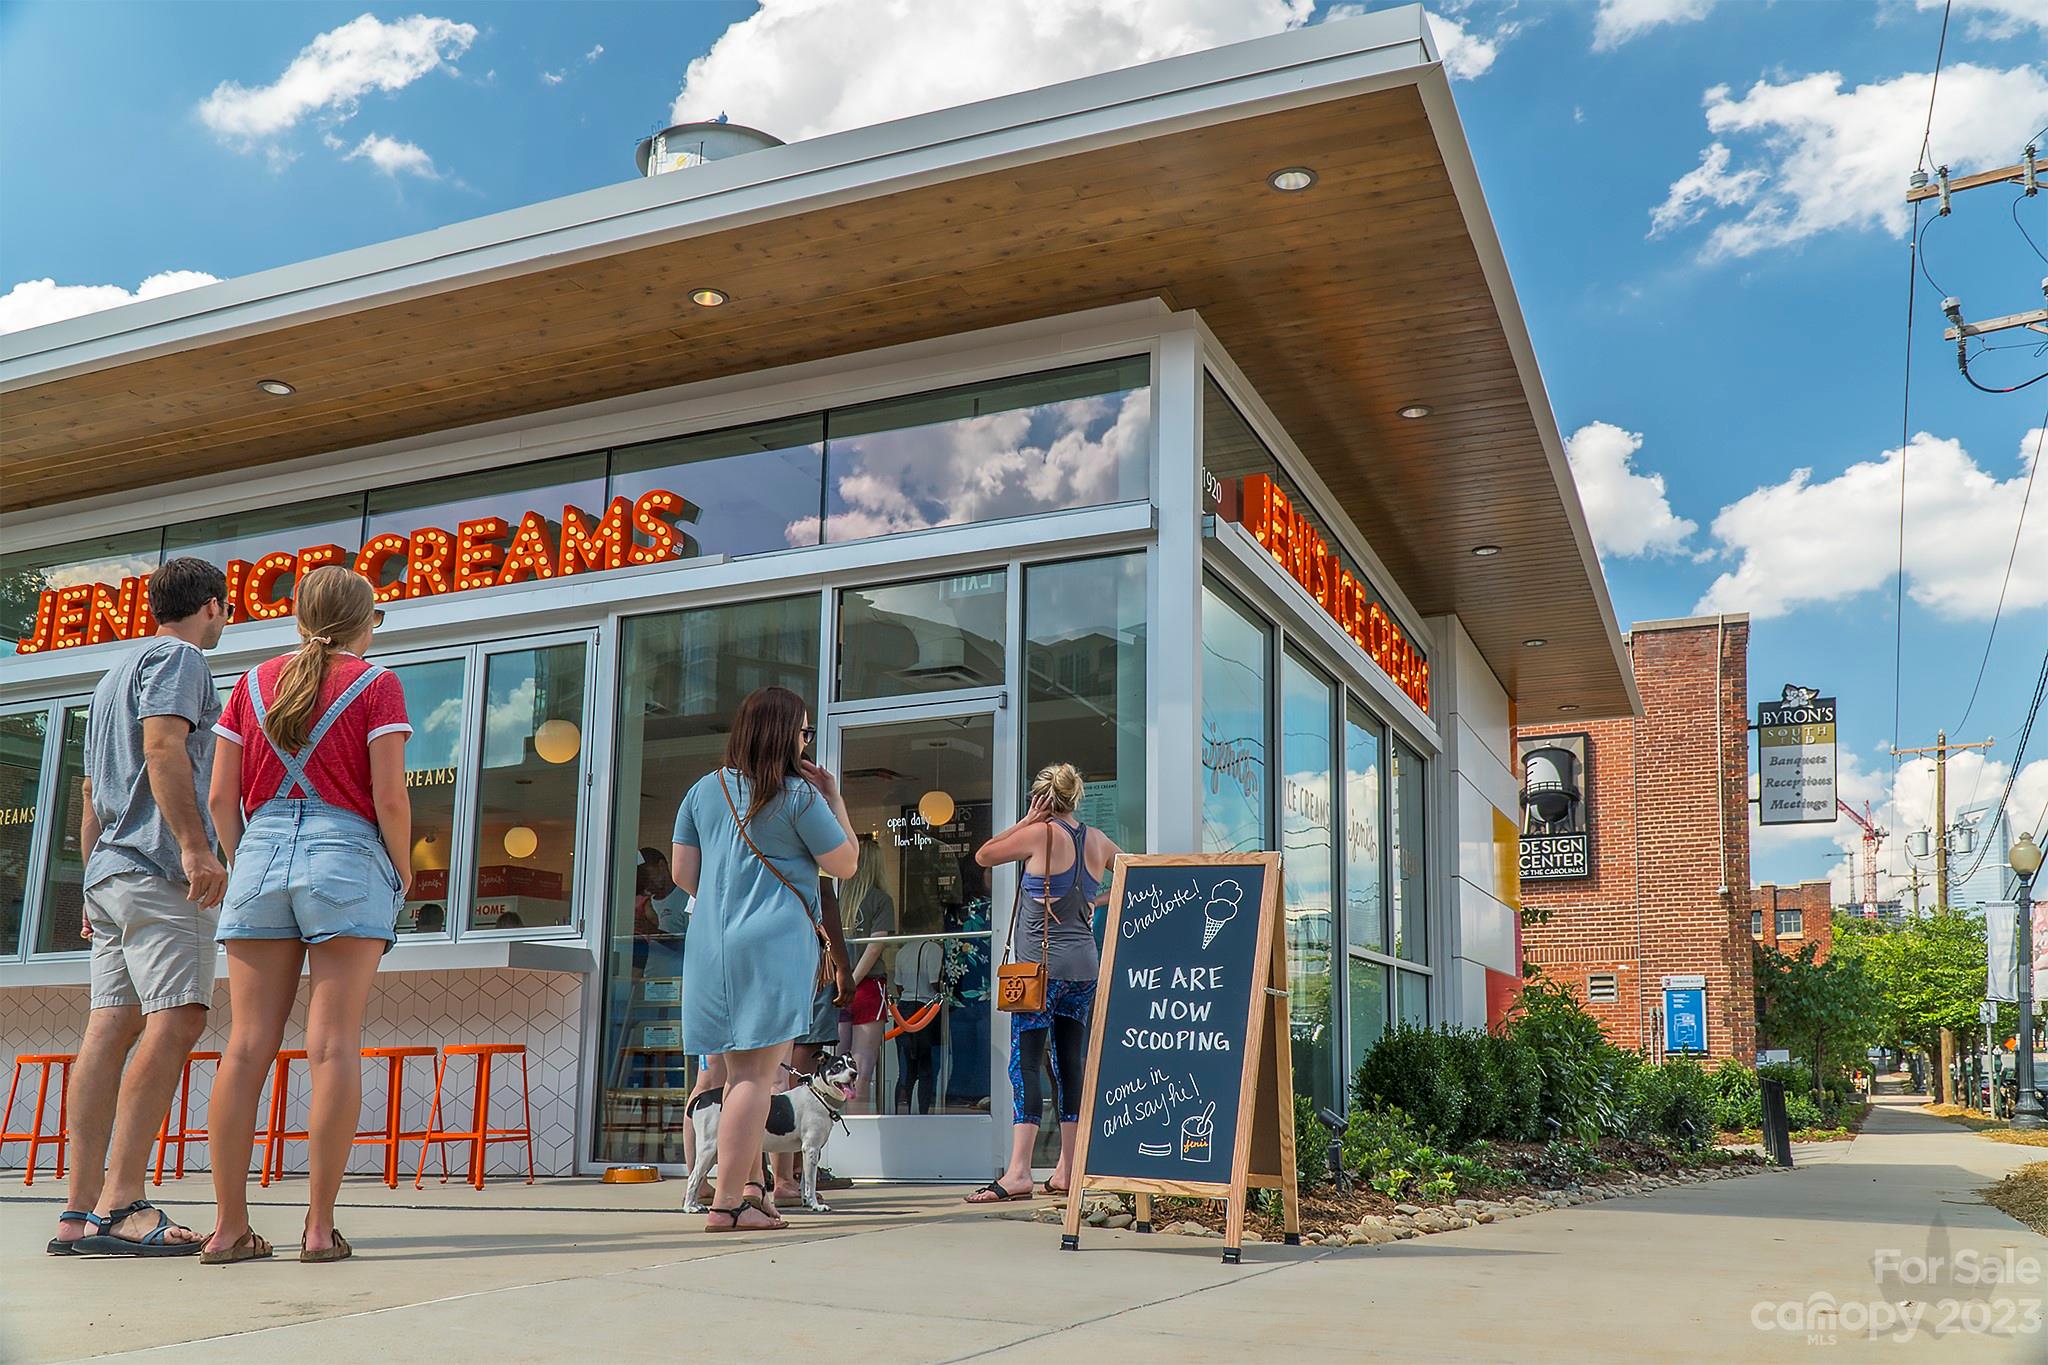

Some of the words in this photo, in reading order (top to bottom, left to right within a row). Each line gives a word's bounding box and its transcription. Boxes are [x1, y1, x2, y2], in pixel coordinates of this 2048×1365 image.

[1202, 466, 1222, 504] 1920
[16, 574, 158, 655] JENI
[353, 489, 685, 604] CREAMS
[1331, 556, 1367, 648] ICE
[1762, 707, 1834, 726] BYRON'S
[1767, 726, 1828, 738] SOUTH
[1769, 756, 1828, 768] Banquets
[406, 767, 456, 788] REAMS
[1765, 775, 1833, 790] Receptions
[1769, 798, 1829, 812] Meetings
[0, 806, 36, 826] REAMS
[886, 817, 908, 833] open
[910, 811, 932, 831] daily
[1518, 838, 1584, 856] DESIGN
[1518, 852, 1585, 870] CENTER
[1518, 869, 1530, 877] OF
[1531, 868, 1544, 876] THE
[1544, 866, 1585, 875] CAROLINAS
[1126, 880, 1164, 911] hey,
[476, 904, 507, 917] HOME
[1122, 879, 1203, 940] Charlotte!
[1127, 966, 1163, 990] WE
[1170, 965, 1225, 991] ARE
[1149, 998, 1212, 1023] NOW
[1121, 1028, 1230, 1052] SCOOPING
[1105, 1078, 1147, 1106] come
[1149, 1066, 1170, 1086] in
[1103, 1103, 1133, 1138] and
[1135, 1093, 1171, 1126] say
